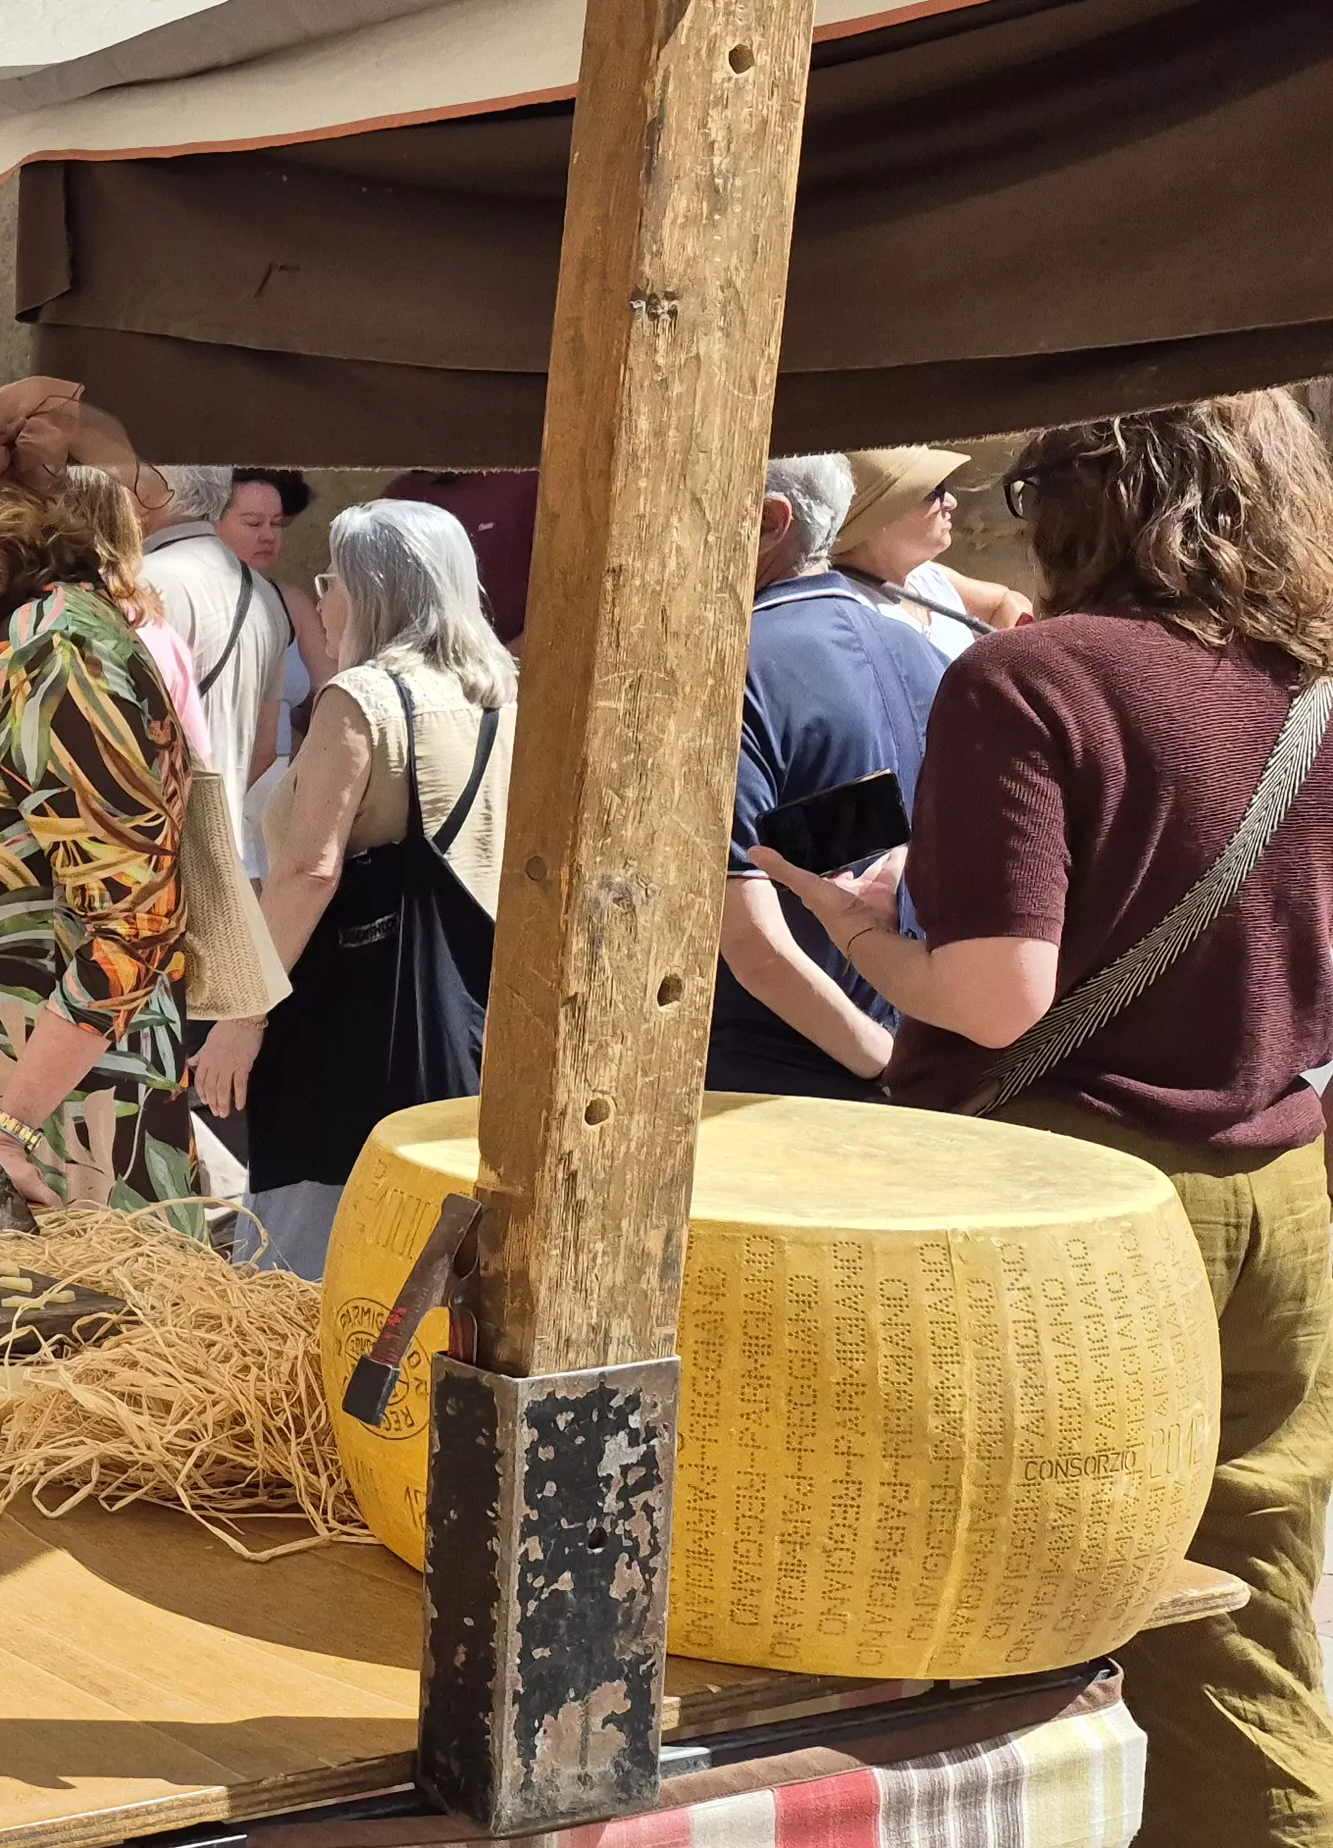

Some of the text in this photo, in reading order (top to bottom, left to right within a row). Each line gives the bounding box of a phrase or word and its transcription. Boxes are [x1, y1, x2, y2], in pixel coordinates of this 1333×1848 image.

[689, 1265, 727, 1444] REGGIANO
[739, 1235, 776, 1450] PARMIGIANO
[785, 1273, 820, 1453] REGGIANO
[832, 1239, 868, 1458] PARMIGIANO
[879, 1277, 914, 1461] REGGIANO
[919, 1242, 965, 1462] PARMIGIANO
[967, 1277, 1006, 1462] REGGIANO
[1001, 1242, 1047, 1460] PARMIGIANO
[1042, 1277, 1082, 1459] REGGIANO
[1066, 1237, 1115, 1453] PARMIGIANO
[1110, 1271, 1147, 1450] REGGIANO
[680, 1462, 718, 1648] PARMIGIANO
[729, 1469, 767, 1626] REGGIANO
[816, 1477, 862, 1637] REGGIANO
[1024, 1449, 1137, 1481] CONSORZIO
[769, 1475, 816, 1660] PARMIGIANO
[856, 1479, 910, 1667] PARMIGIANO
[982, 1482, 1043, 1642] REGGIANO
